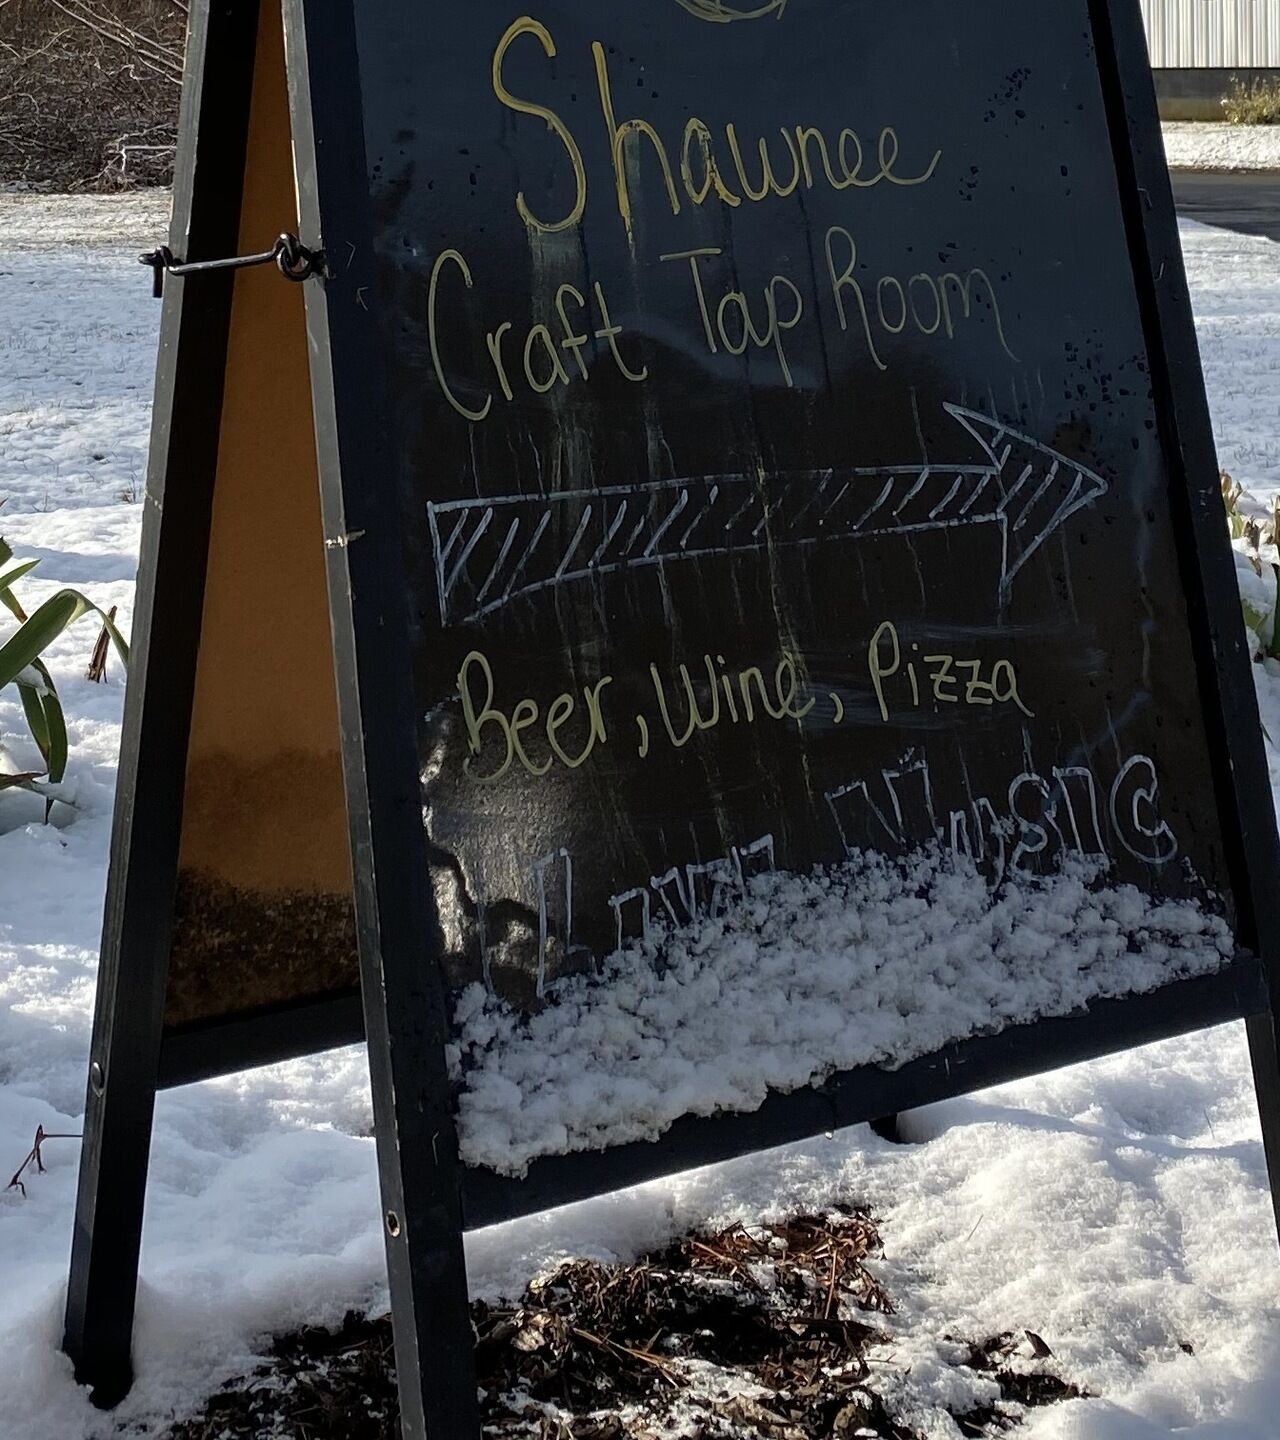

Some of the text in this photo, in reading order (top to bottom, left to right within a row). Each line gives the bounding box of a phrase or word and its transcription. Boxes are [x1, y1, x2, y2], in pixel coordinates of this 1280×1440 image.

[492, 17, 942, 233] Shawnee
[427, 225, 1021, 422] Craft Tap Room
[456, 621, 1036, 784] Beer, Wine, Pizza
